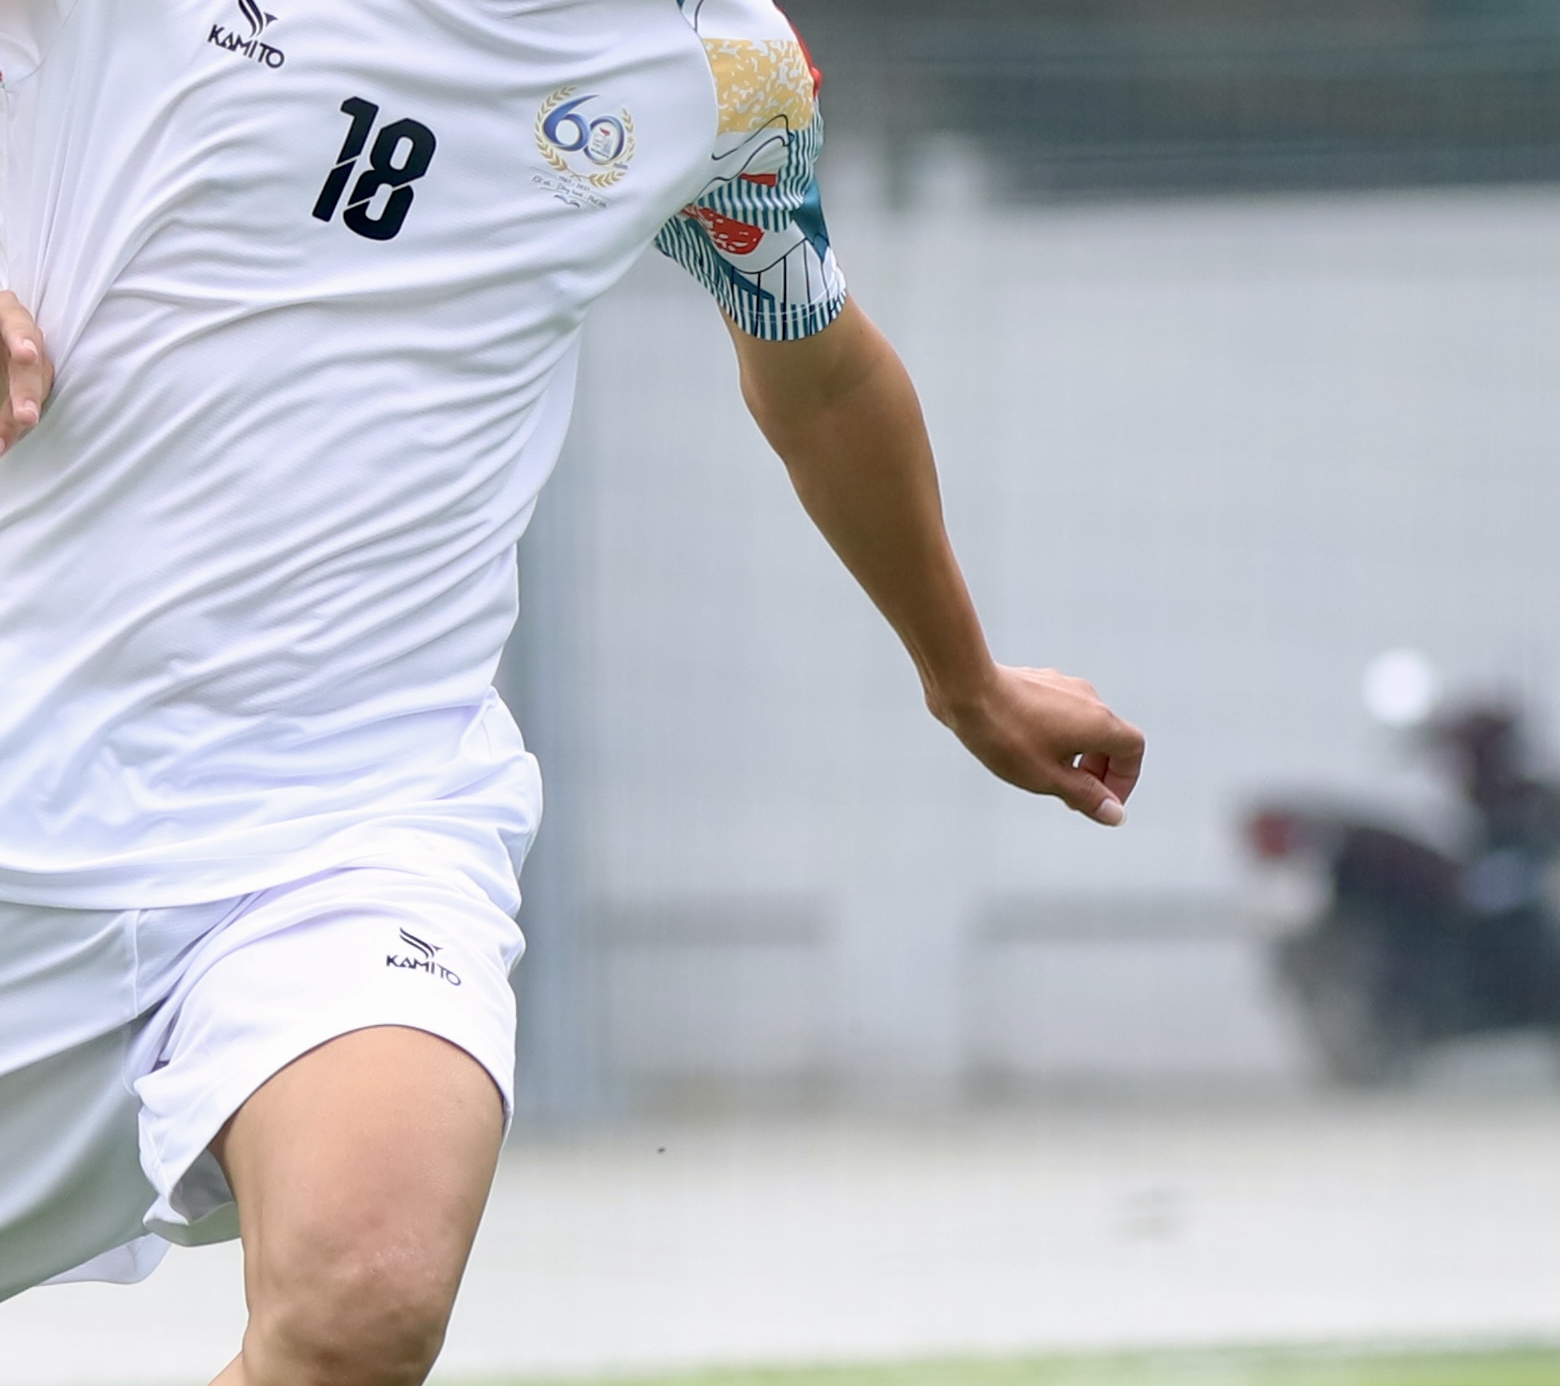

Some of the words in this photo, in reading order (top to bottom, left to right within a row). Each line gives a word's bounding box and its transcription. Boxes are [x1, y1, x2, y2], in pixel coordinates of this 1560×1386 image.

[207, 24, 285, 69] KAMITO
[543, 94, 625, 166] 60
[312, 96, 437, 241] 18
[386, 954, 462, 986] KAMITO
